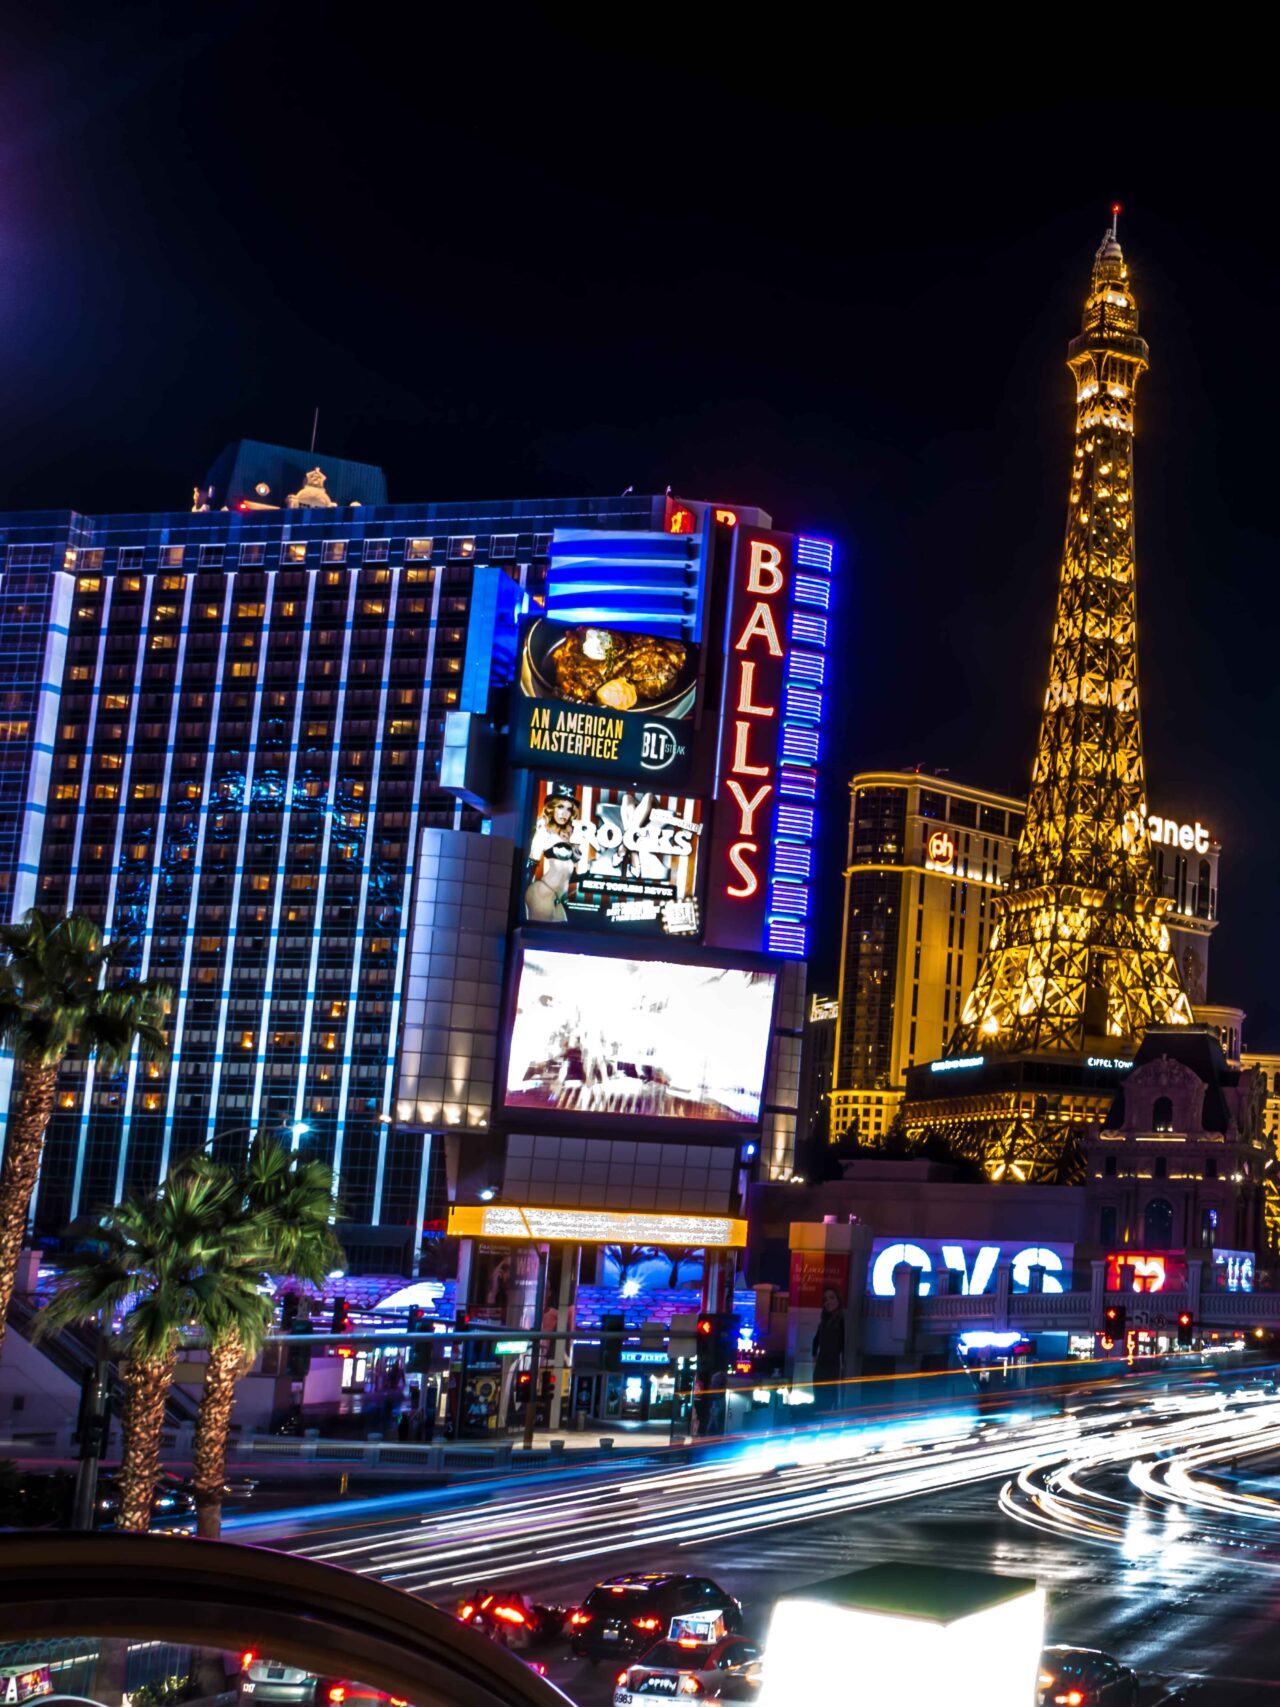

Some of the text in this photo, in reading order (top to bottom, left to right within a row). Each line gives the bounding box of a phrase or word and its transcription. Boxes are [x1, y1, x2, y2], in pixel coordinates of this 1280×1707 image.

[530, 707, 624, 740] AN AMERICAN
[529, 729, 619, 760] MASTERPIECE
[641, 731, 669, 760] BLT
[664, 742, 686, 756] STEAK
[571, 819, 693, 857] ROCKS
[872, 1243, 1064, 1297] CVS
[648, 1678, 677, 1692] OPIUM
